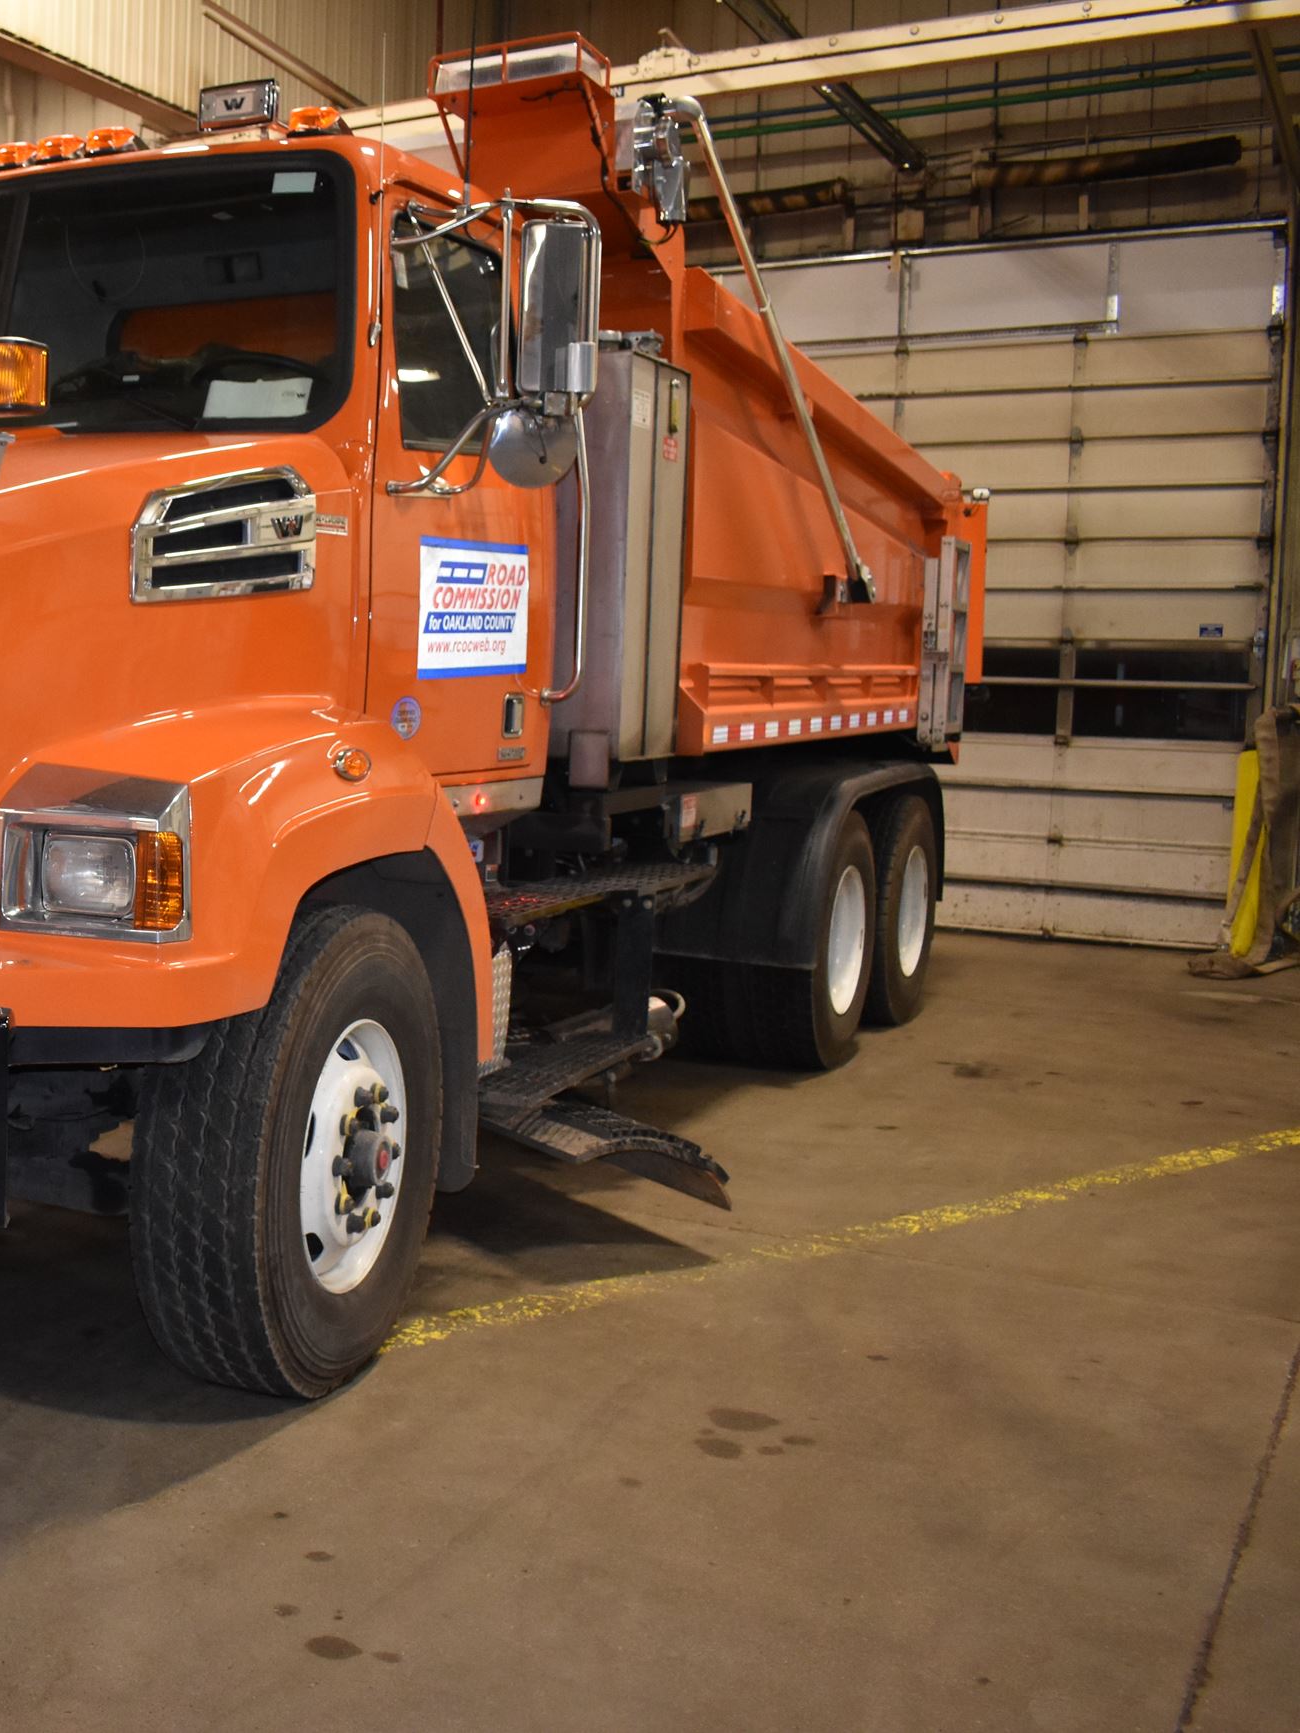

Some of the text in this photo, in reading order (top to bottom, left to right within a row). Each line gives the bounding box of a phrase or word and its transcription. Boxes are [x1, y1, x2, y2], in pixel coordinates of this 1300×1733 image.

[485, 563, 526, 587] ROAD
[432, 586, 522, 610] COMMISSION
[428, 614, 515, 632] for OAKLAND COUNTY
[427, 637, 507, 656] www.rcocweb.org
